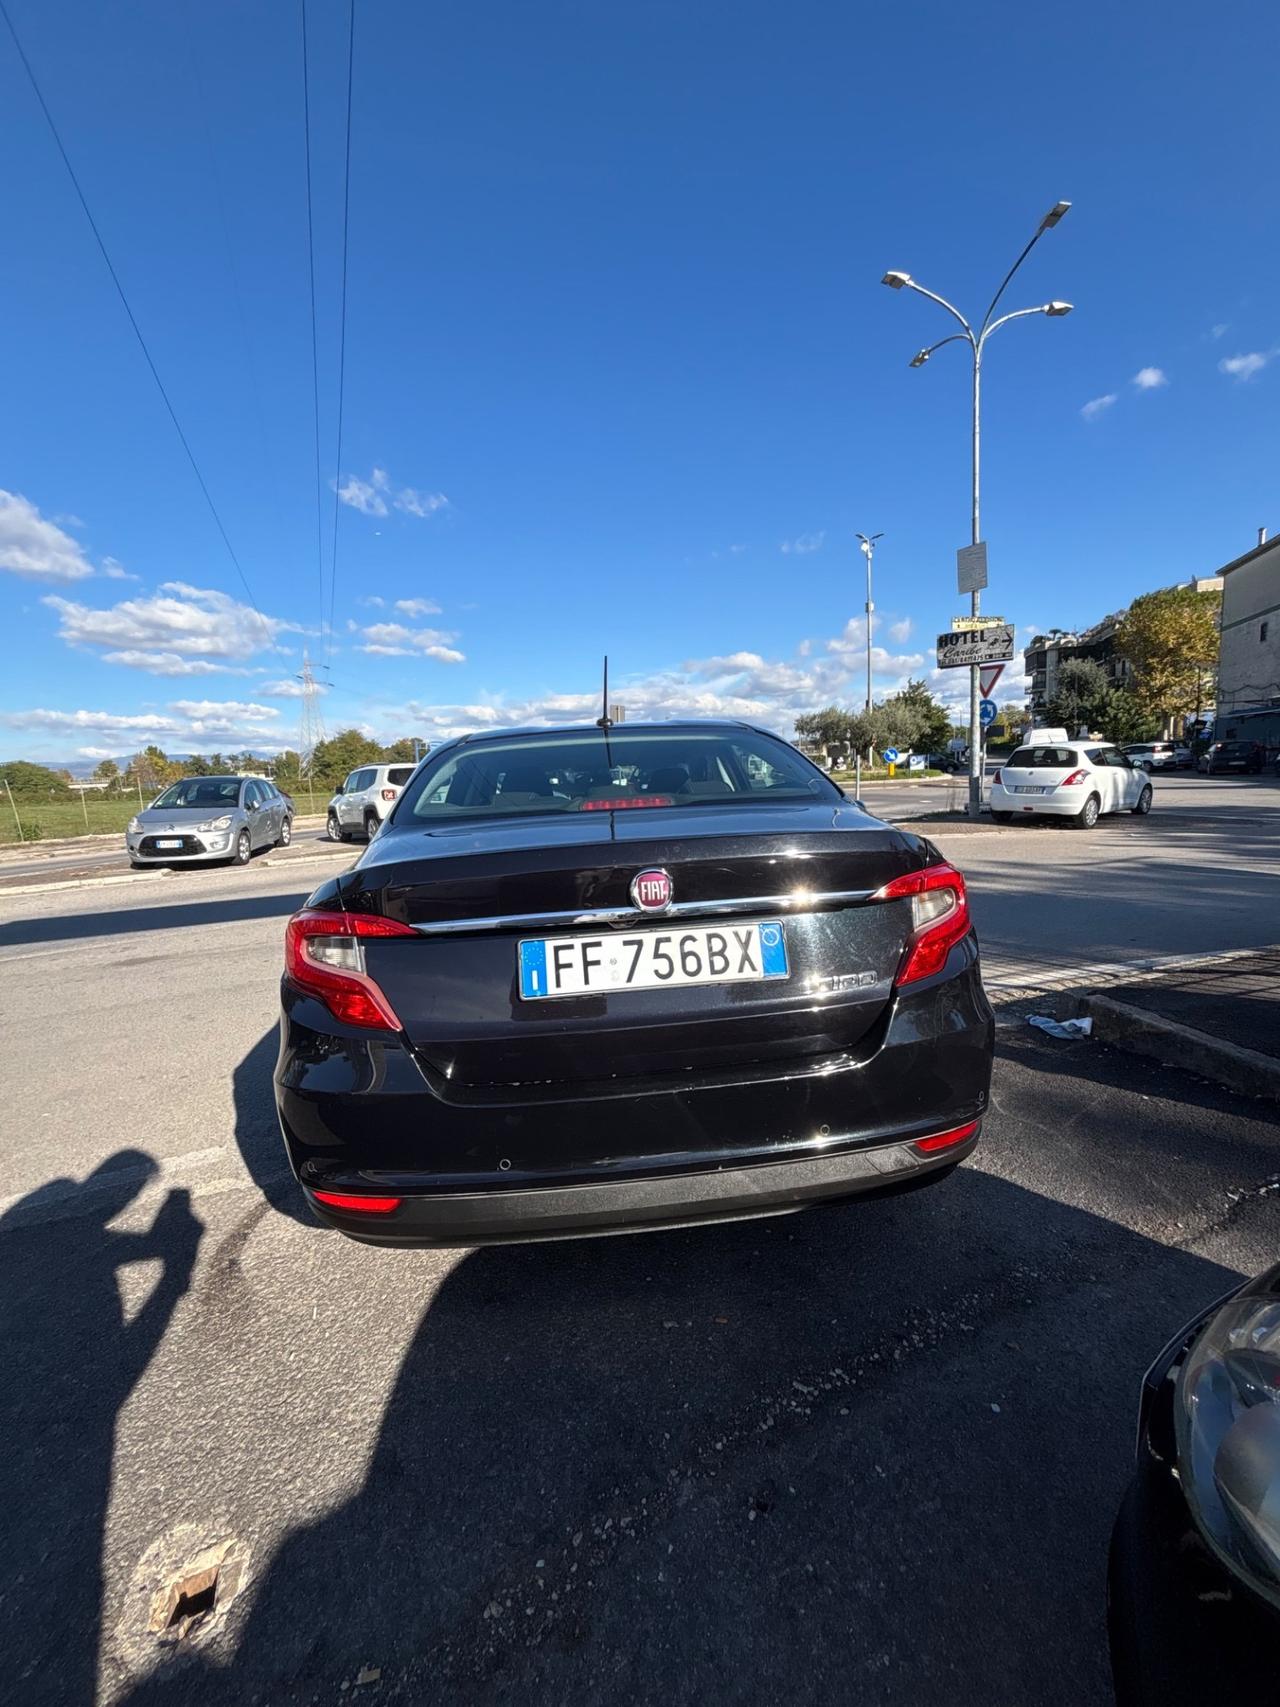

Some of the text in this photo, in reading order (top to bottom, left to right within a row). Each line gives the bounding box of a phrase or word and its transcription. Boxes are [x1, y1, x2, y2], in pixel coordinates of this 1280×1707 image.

[938, 630, 987, 648] HOTEL
[943, 644, 982, 659] Caribe
[641, 880, 668, 900] FIAT
